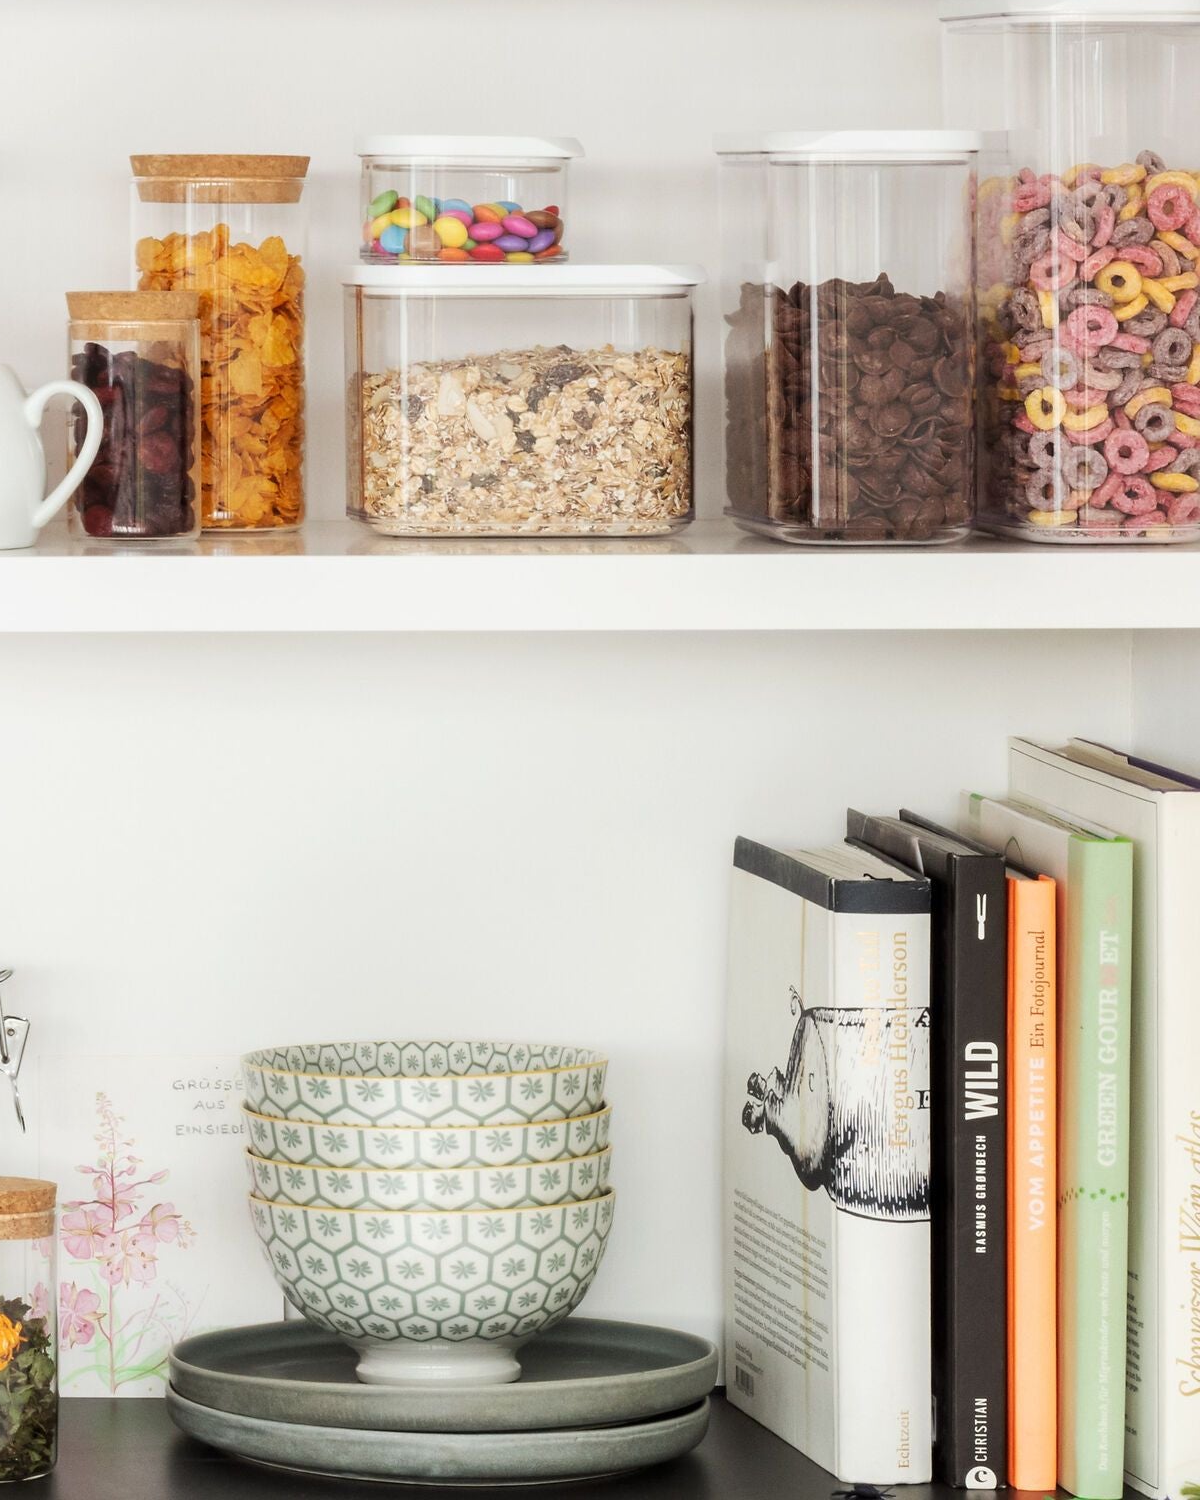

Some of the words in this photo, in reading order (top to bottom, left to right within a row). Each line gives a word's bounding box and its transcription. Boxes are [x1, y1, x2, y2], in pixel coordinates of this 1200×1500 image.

[886, 930, 908, 1062] Henderson
[1027, 930, 1051, 1017] Fotojournal
[1028, 1022, 1046, 1048] Ein
[172, 1077, 246, 1092] GRÜSSE
[193, 1100, 226, 1111] AUS
[886, 1068, 915, 1149] Fergus
[964, 1041, 999, 1121] WILD
[1028, 1056, 1046, 1169] APPETITE
[1097, 1070, 1118, 1167] GREEN
[974, 1134, 987, 1200] GRØNBECH
[974, 1204, 987, 1254] RASMUS
[1028, 1177, 1046, 1231] VOM
[896, 1409, 910, 1469] Echtzeit
[974, 1397, 988, 1462] CHRISTIAN
